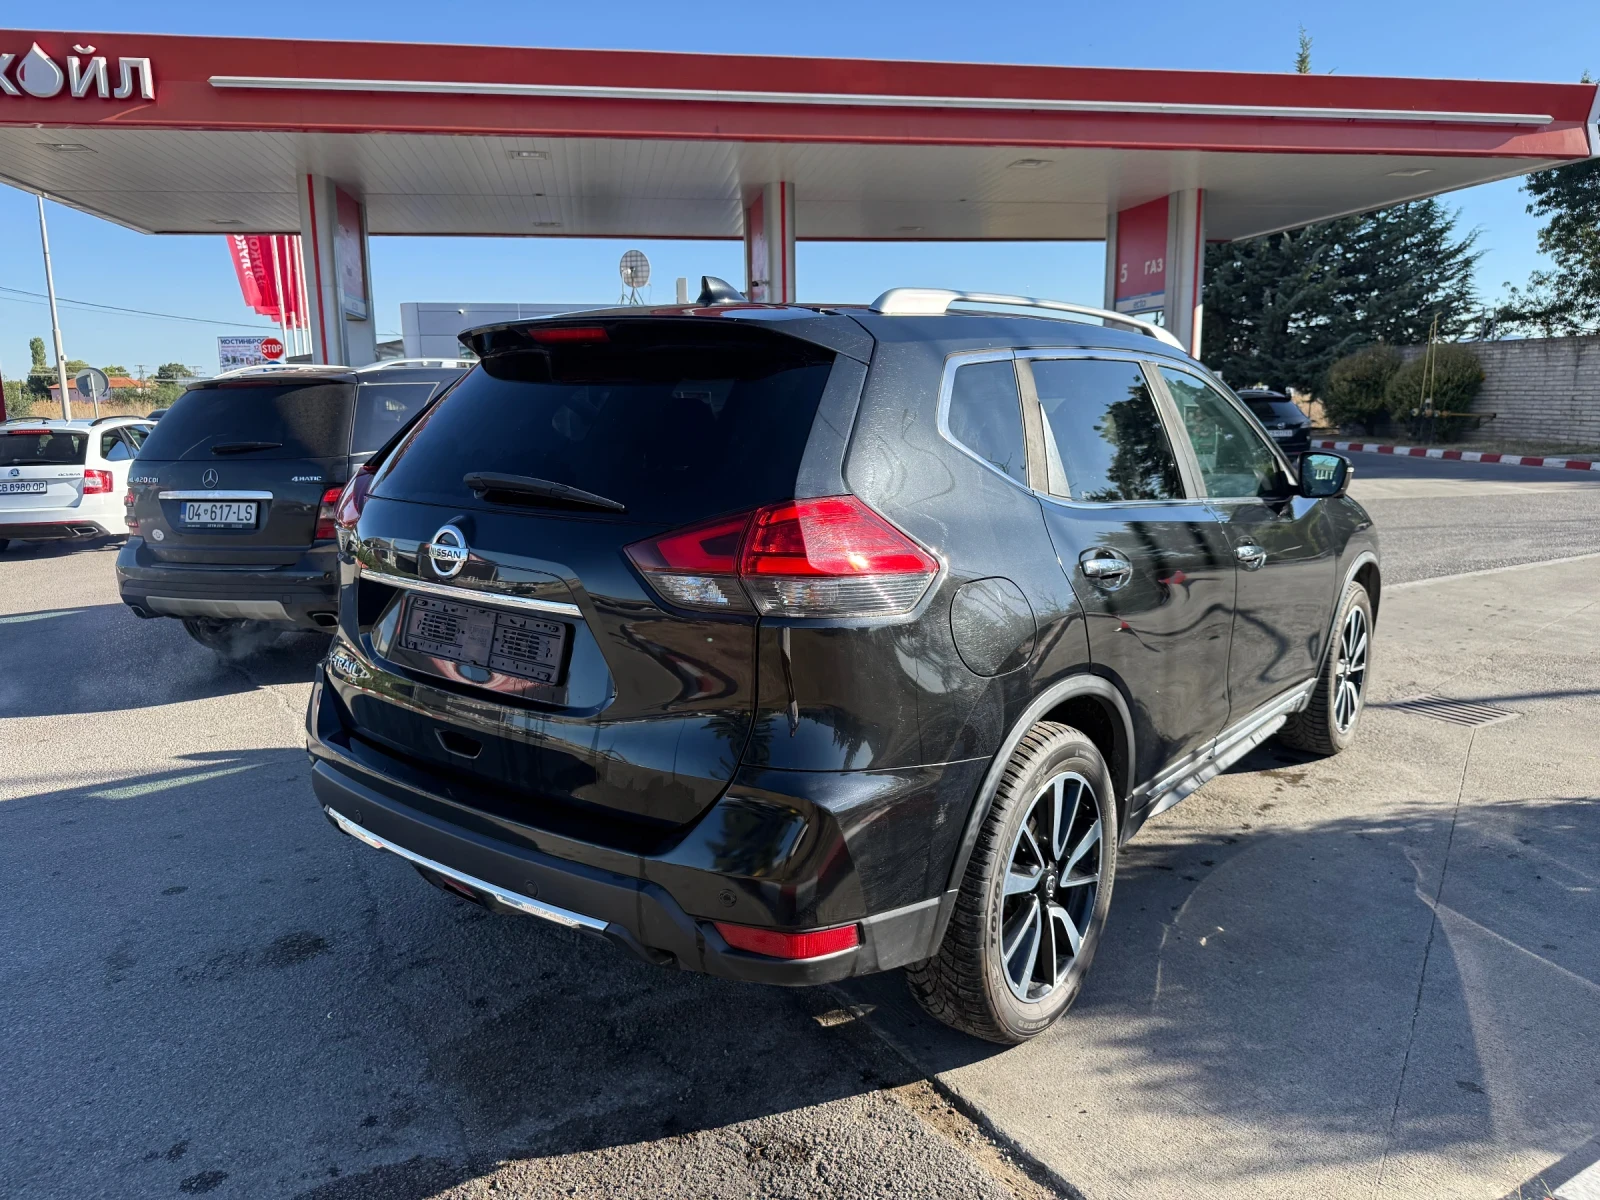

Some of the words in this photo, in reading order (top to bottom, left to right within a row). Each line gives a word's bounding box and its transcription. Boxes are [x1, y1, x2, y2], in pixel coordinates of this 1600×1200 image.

[1120, 263, 1128, 283] 5
[1144, 258, 1164, 275] ГАЗ
[262, 344, 282, 353] STOP
[0, 483, 8, 492] B
[9, 483, 32, 491] 8980
[33, 482, 45, 491] OP
[187, 504, 202, 521] 04
[210, 504, 253, 521] 617-LS
[430, 546, 462, 559] NISSAN
[329, 651, 361, 678] X-TRAIL
[990, 881, 1001, 948] TOYO
